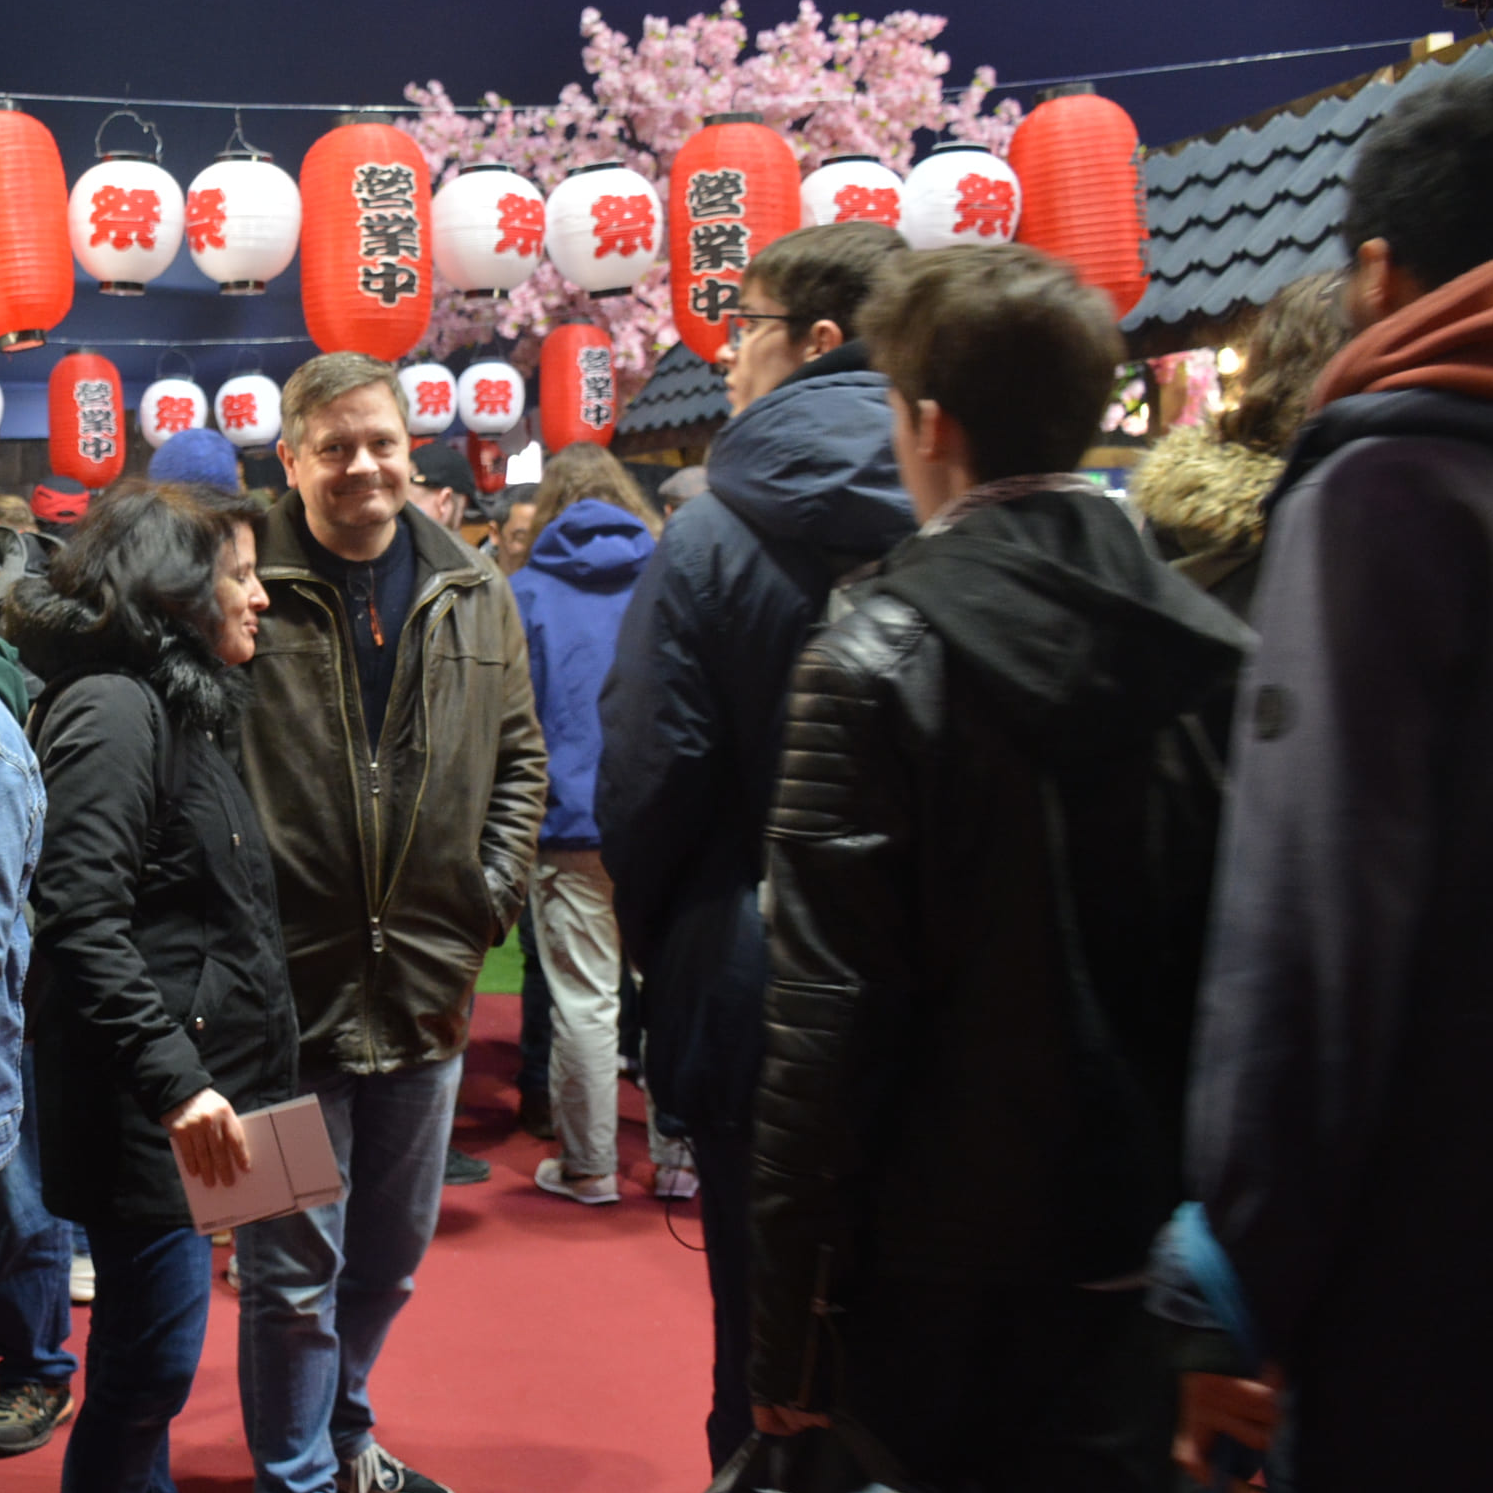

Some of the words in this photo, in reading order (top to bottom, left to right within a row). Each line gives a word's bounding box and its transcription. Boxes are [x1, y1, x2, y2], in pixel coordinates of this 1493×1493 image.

[90, 185, 161, 252] 祭
[494, 193, 546, 258] 祭
[591, 194, 655, 259] 祭
[953, 173, 1014, 237] 祭
[155, 396, 194, 433] 祭
[223, 393, 257, 430] 祭
[416, 381, 451, 416] 祭
[475, 379, 512, 415] 祭
